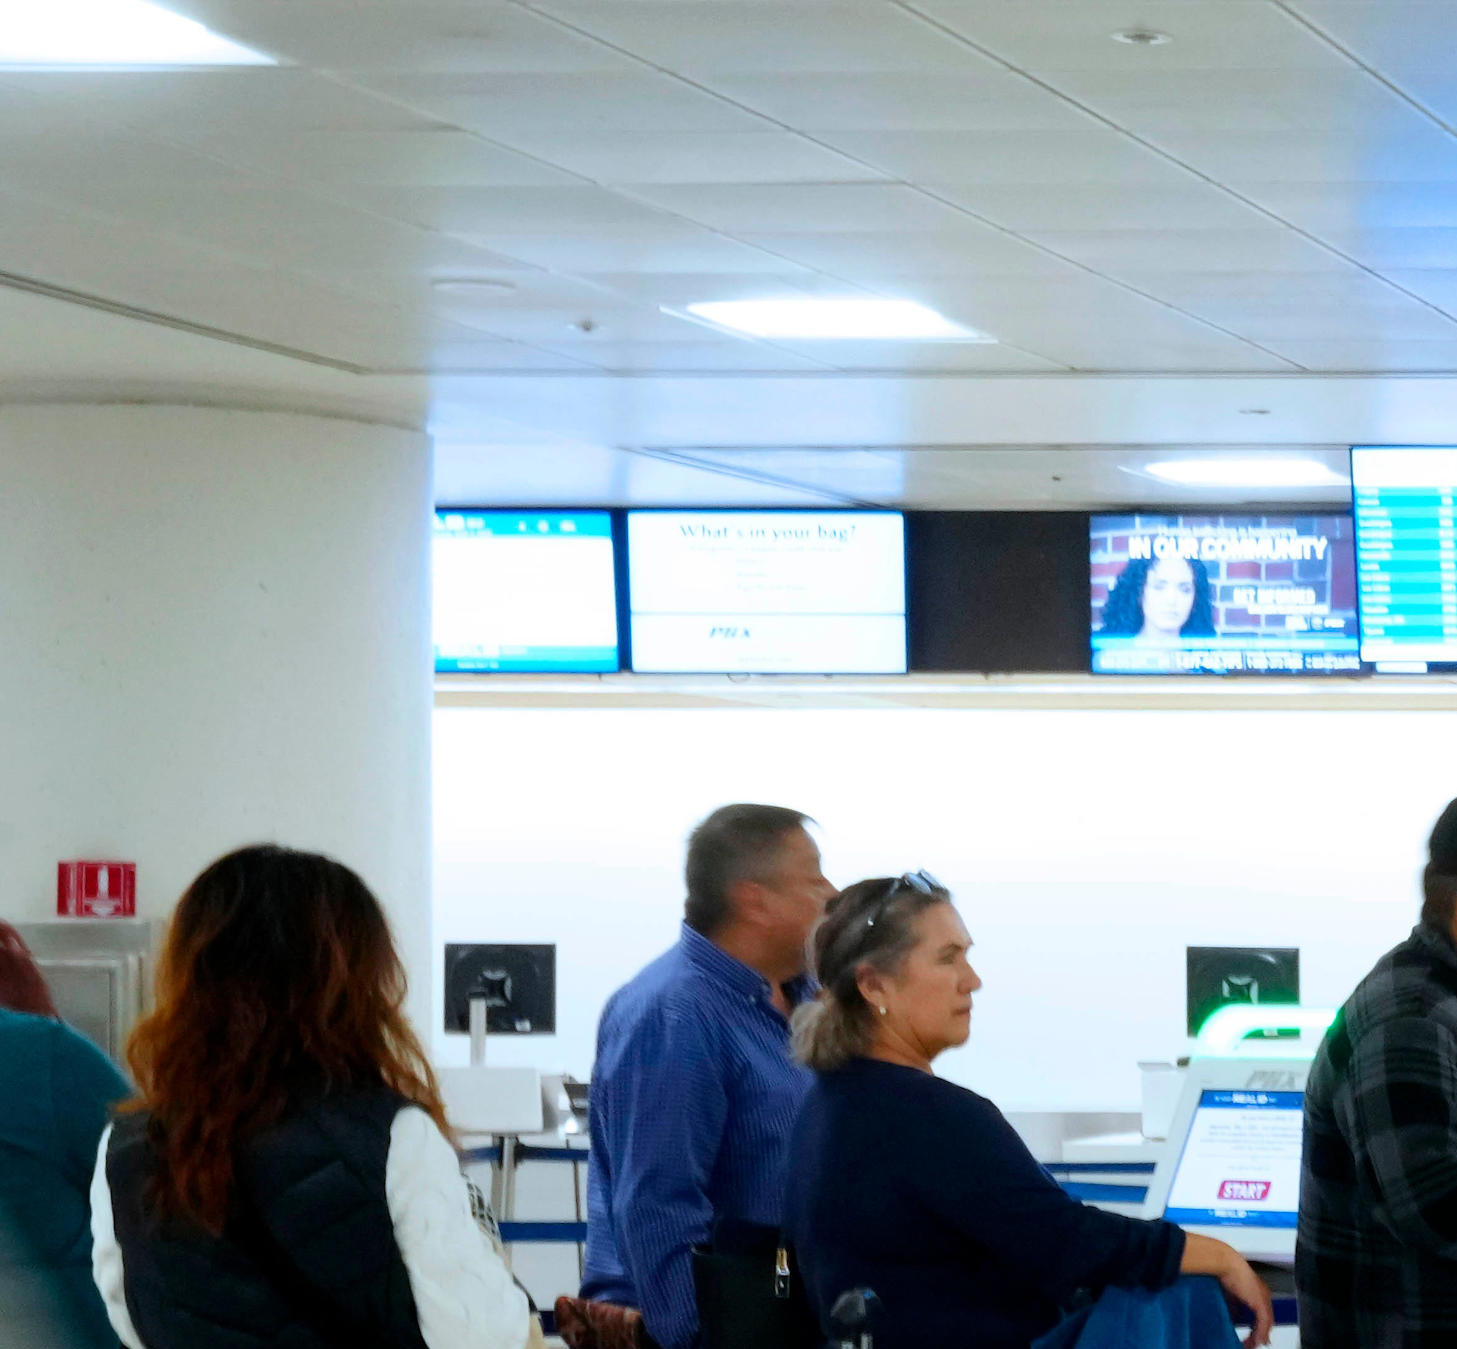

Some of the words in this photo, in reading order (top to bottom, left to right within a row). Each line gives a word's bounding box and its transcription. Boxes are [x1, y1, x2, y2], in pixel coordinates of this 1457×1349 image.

[770, 527, 811, 544] your
[817, 524, 857, 543] bag?
[1128, 536, 1151, 560] IN
[1153, 537, 1199, 560] OUR
[1201, 537, 1327, 560] COMMUNITY
[1223, 1182, 1266, 1200] START
